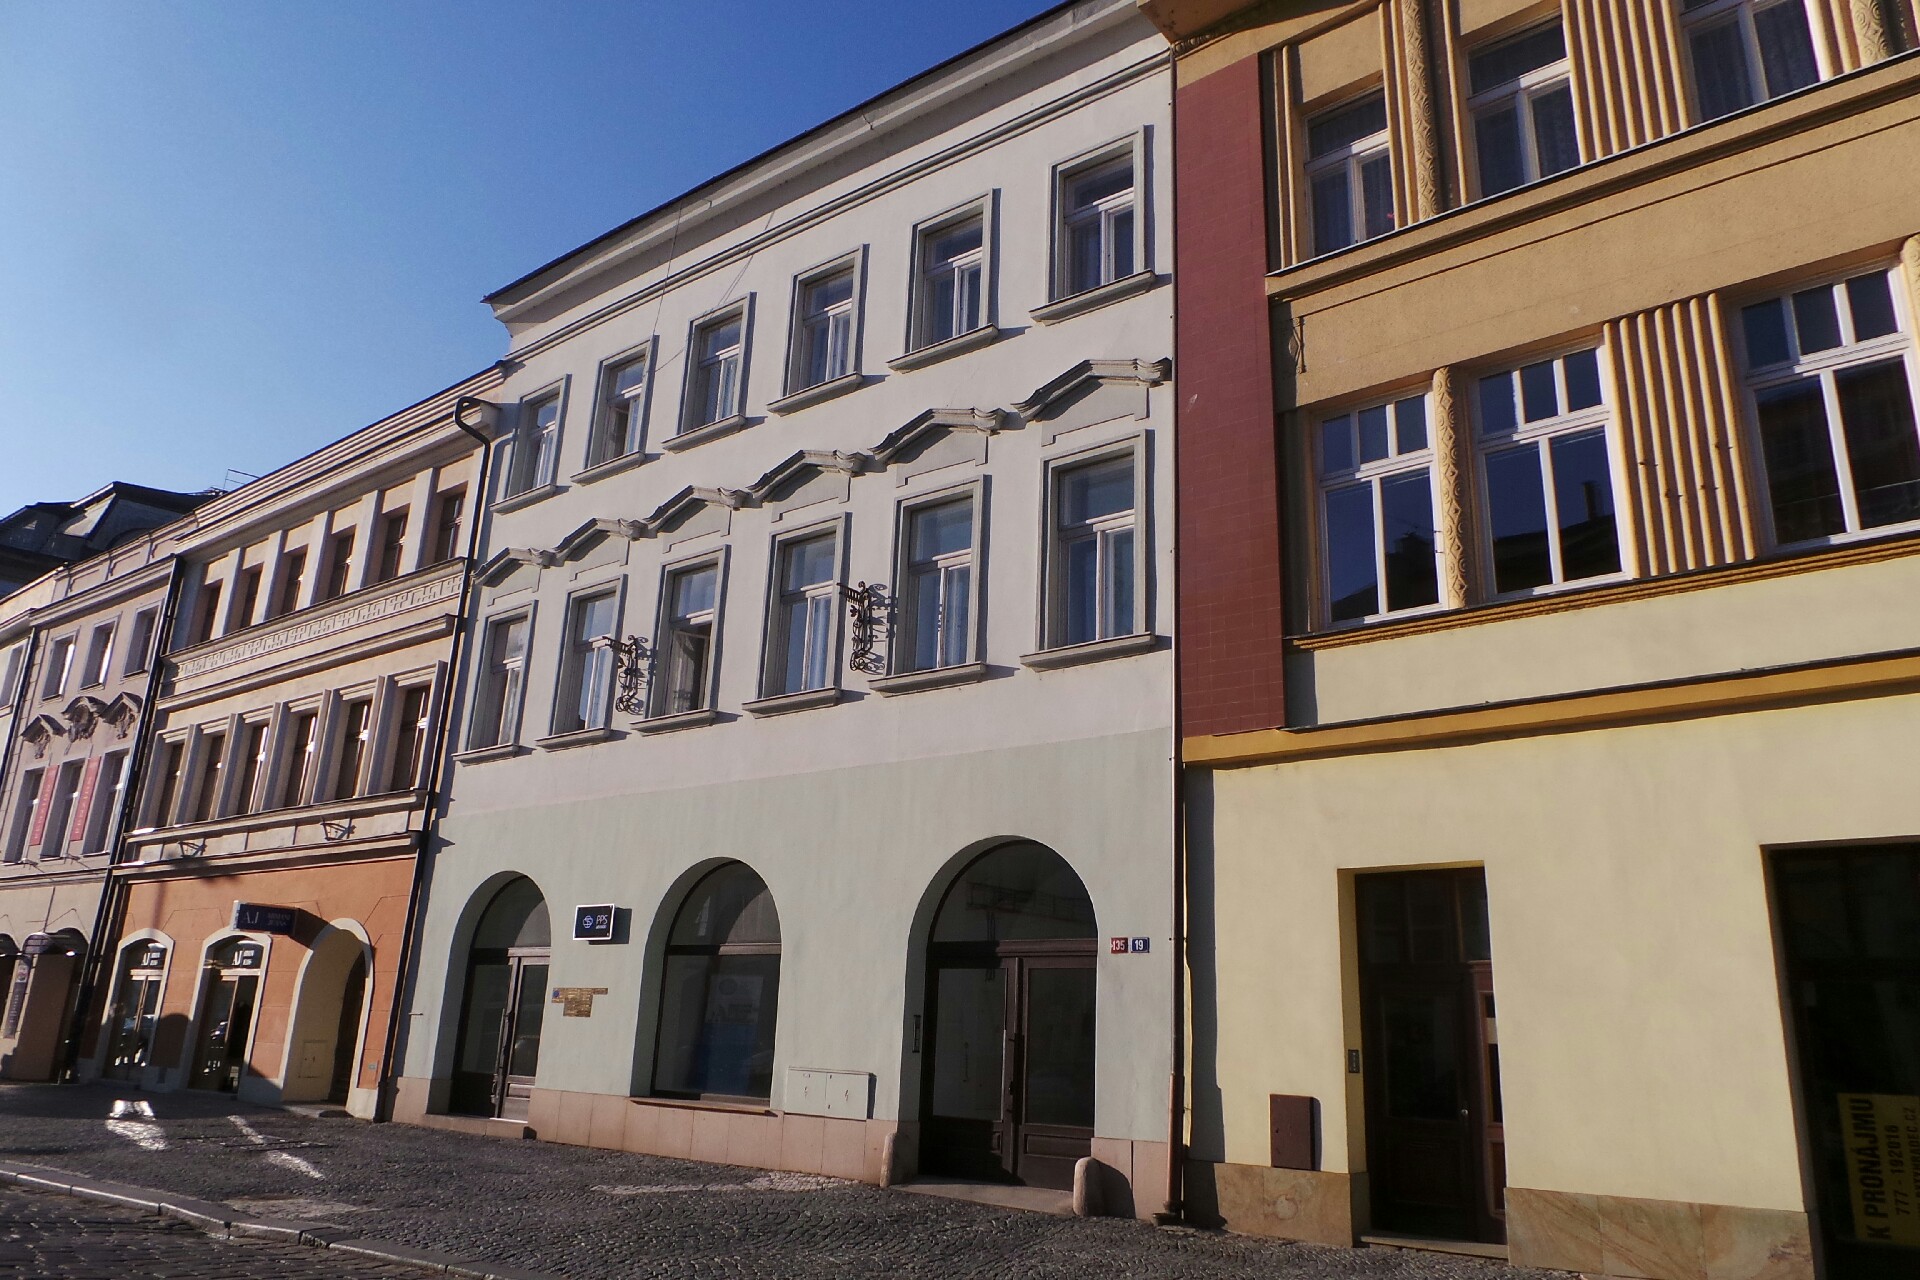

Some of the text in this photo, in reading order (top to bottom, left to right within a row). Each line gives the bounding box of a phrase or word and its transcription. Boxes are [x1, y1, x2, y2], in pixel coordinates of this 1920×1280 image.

[596, 915, 608, 925] PPS
[1135, 940, 1143, 951] 19
[1849, 1098, 1892, 1240] K PRONÁJMU
[1893, 1190, 1910, 1216] 777
